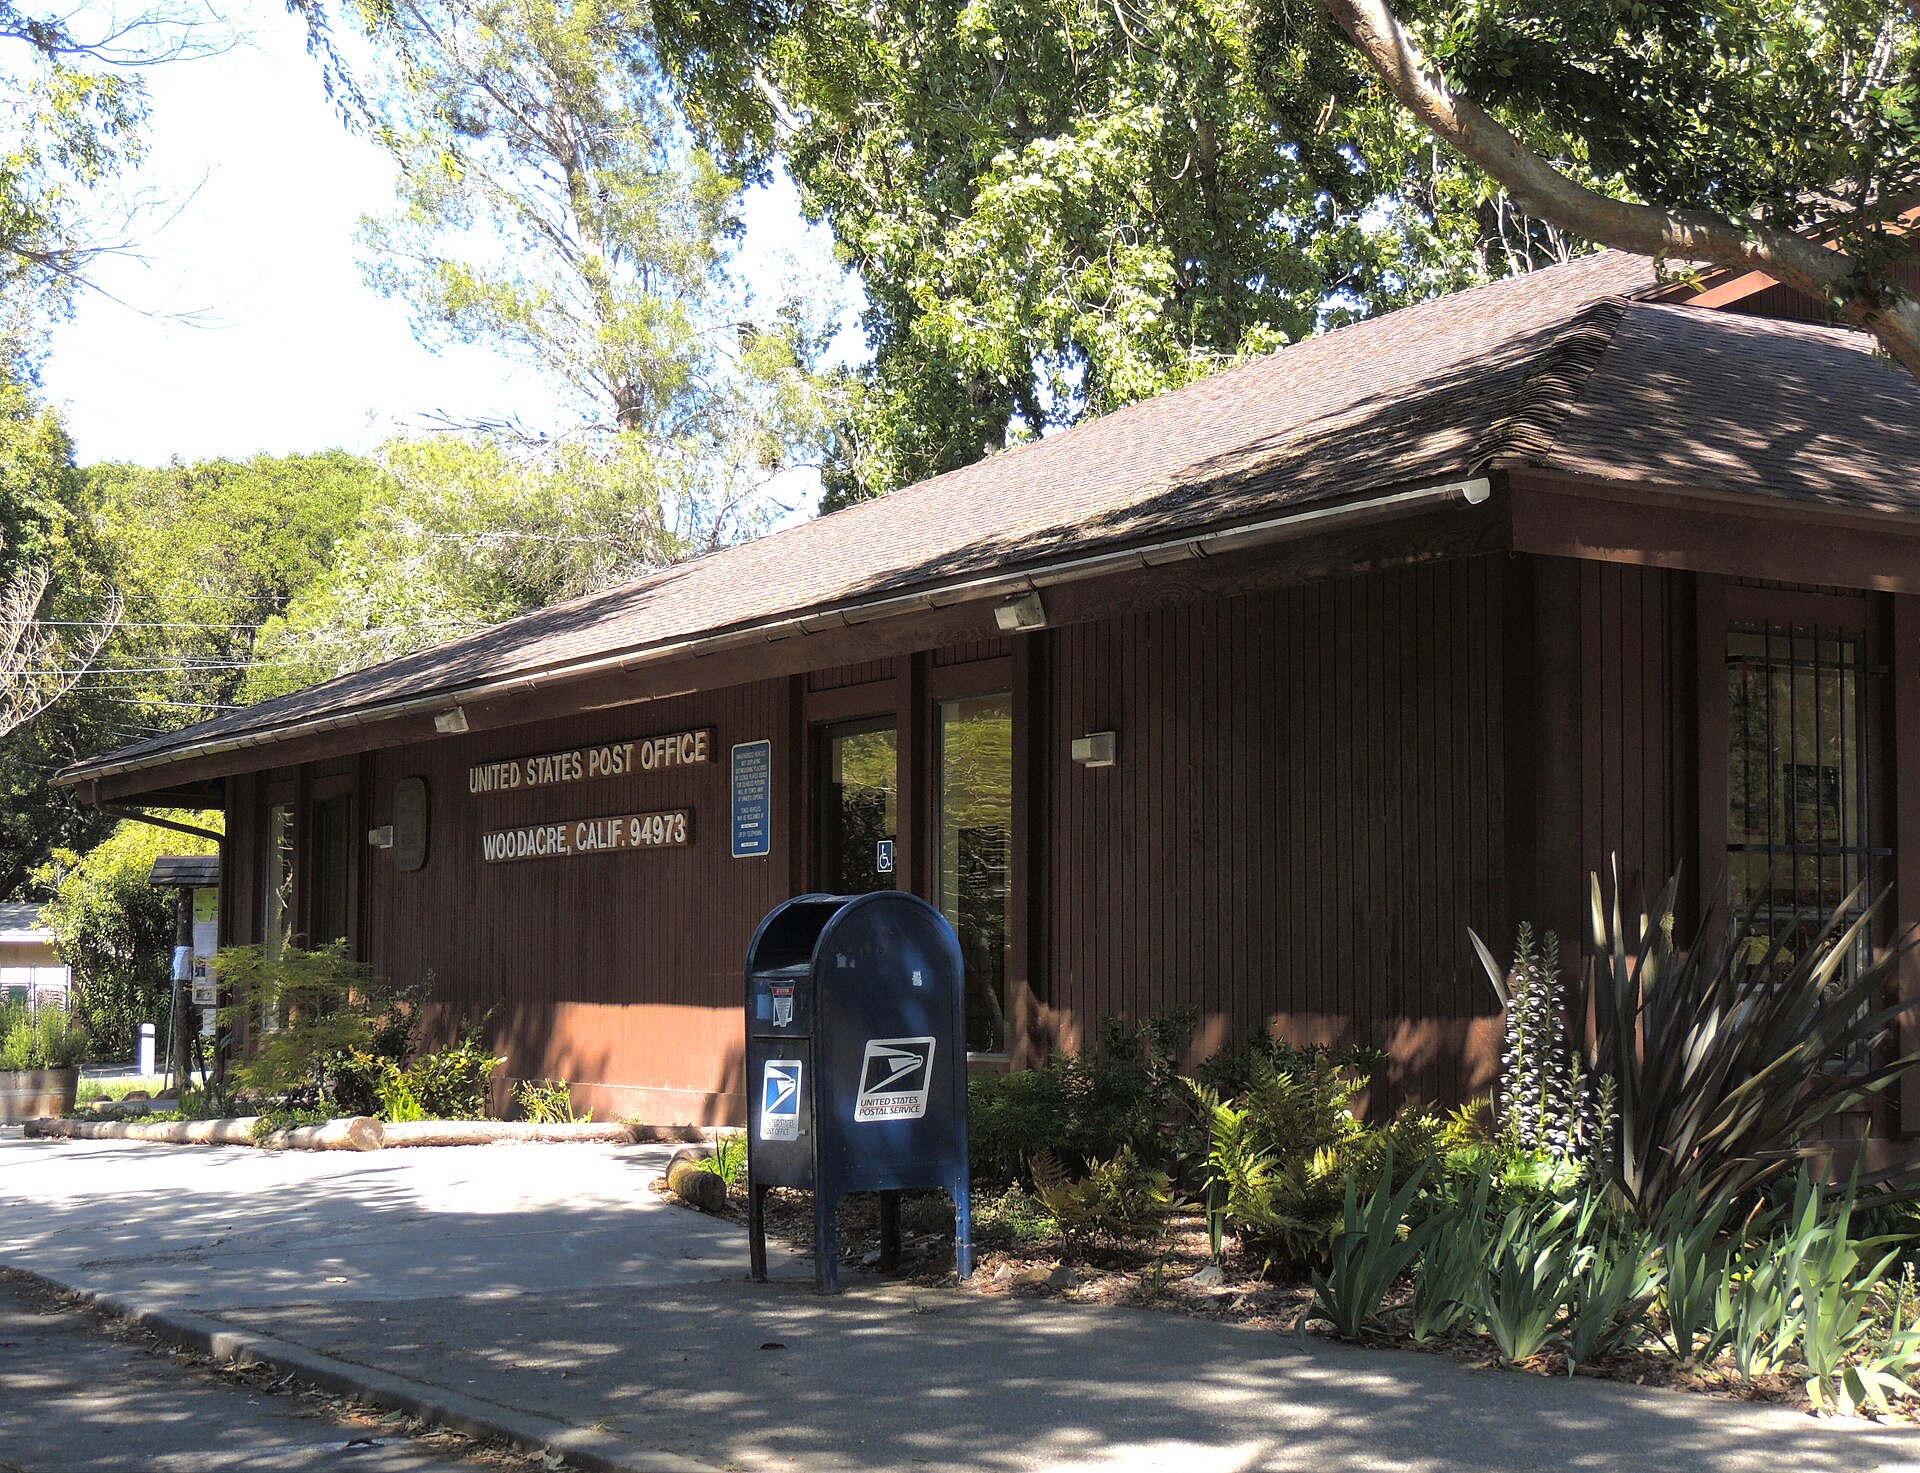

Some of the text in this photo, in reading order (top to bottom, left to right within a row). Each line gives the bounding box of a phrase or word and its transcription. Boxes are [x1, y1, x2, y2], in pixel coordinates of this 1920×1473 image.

[470, 731, 707, 793] UNITED STATES POST OFFICE
[483, 813, 687, 861] WOODACRE, CALIF. 94973
[860, 1096, 919, 1107] UNITED STATES
[859, 1105, 920, 1116] POSTAL SERVICE
[775, 1128, 789, 1136] OFFICE
